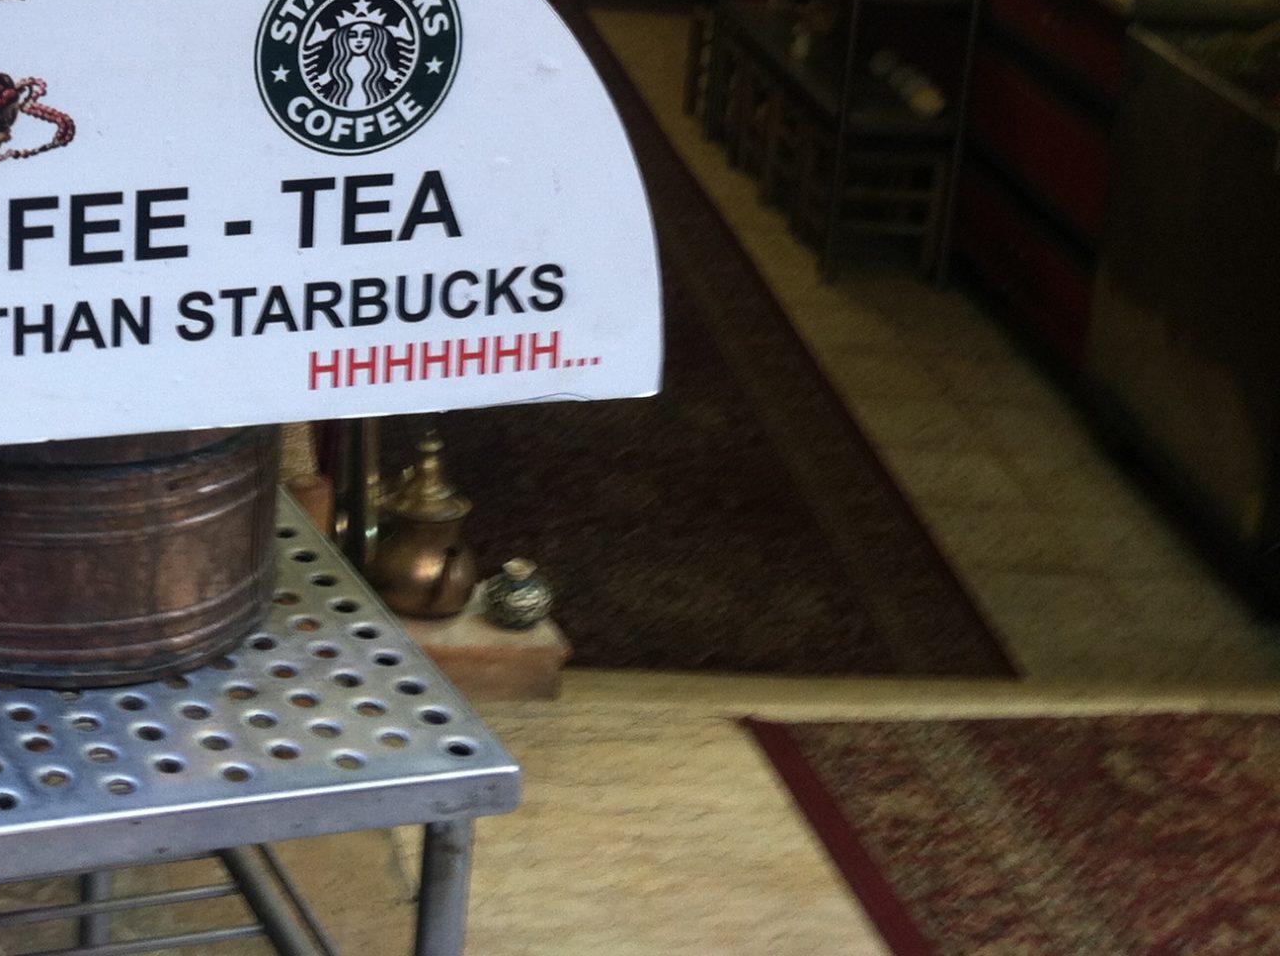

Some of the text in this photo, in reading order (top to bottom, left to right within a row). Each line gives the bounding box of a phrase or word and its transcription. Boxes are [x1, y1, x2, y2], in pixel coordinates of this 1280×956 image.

[286, 91, 424, 144] COFFEE
[280, 169, 464, 250] TEA
[175, 262, 566, 343] STARBUCKS
